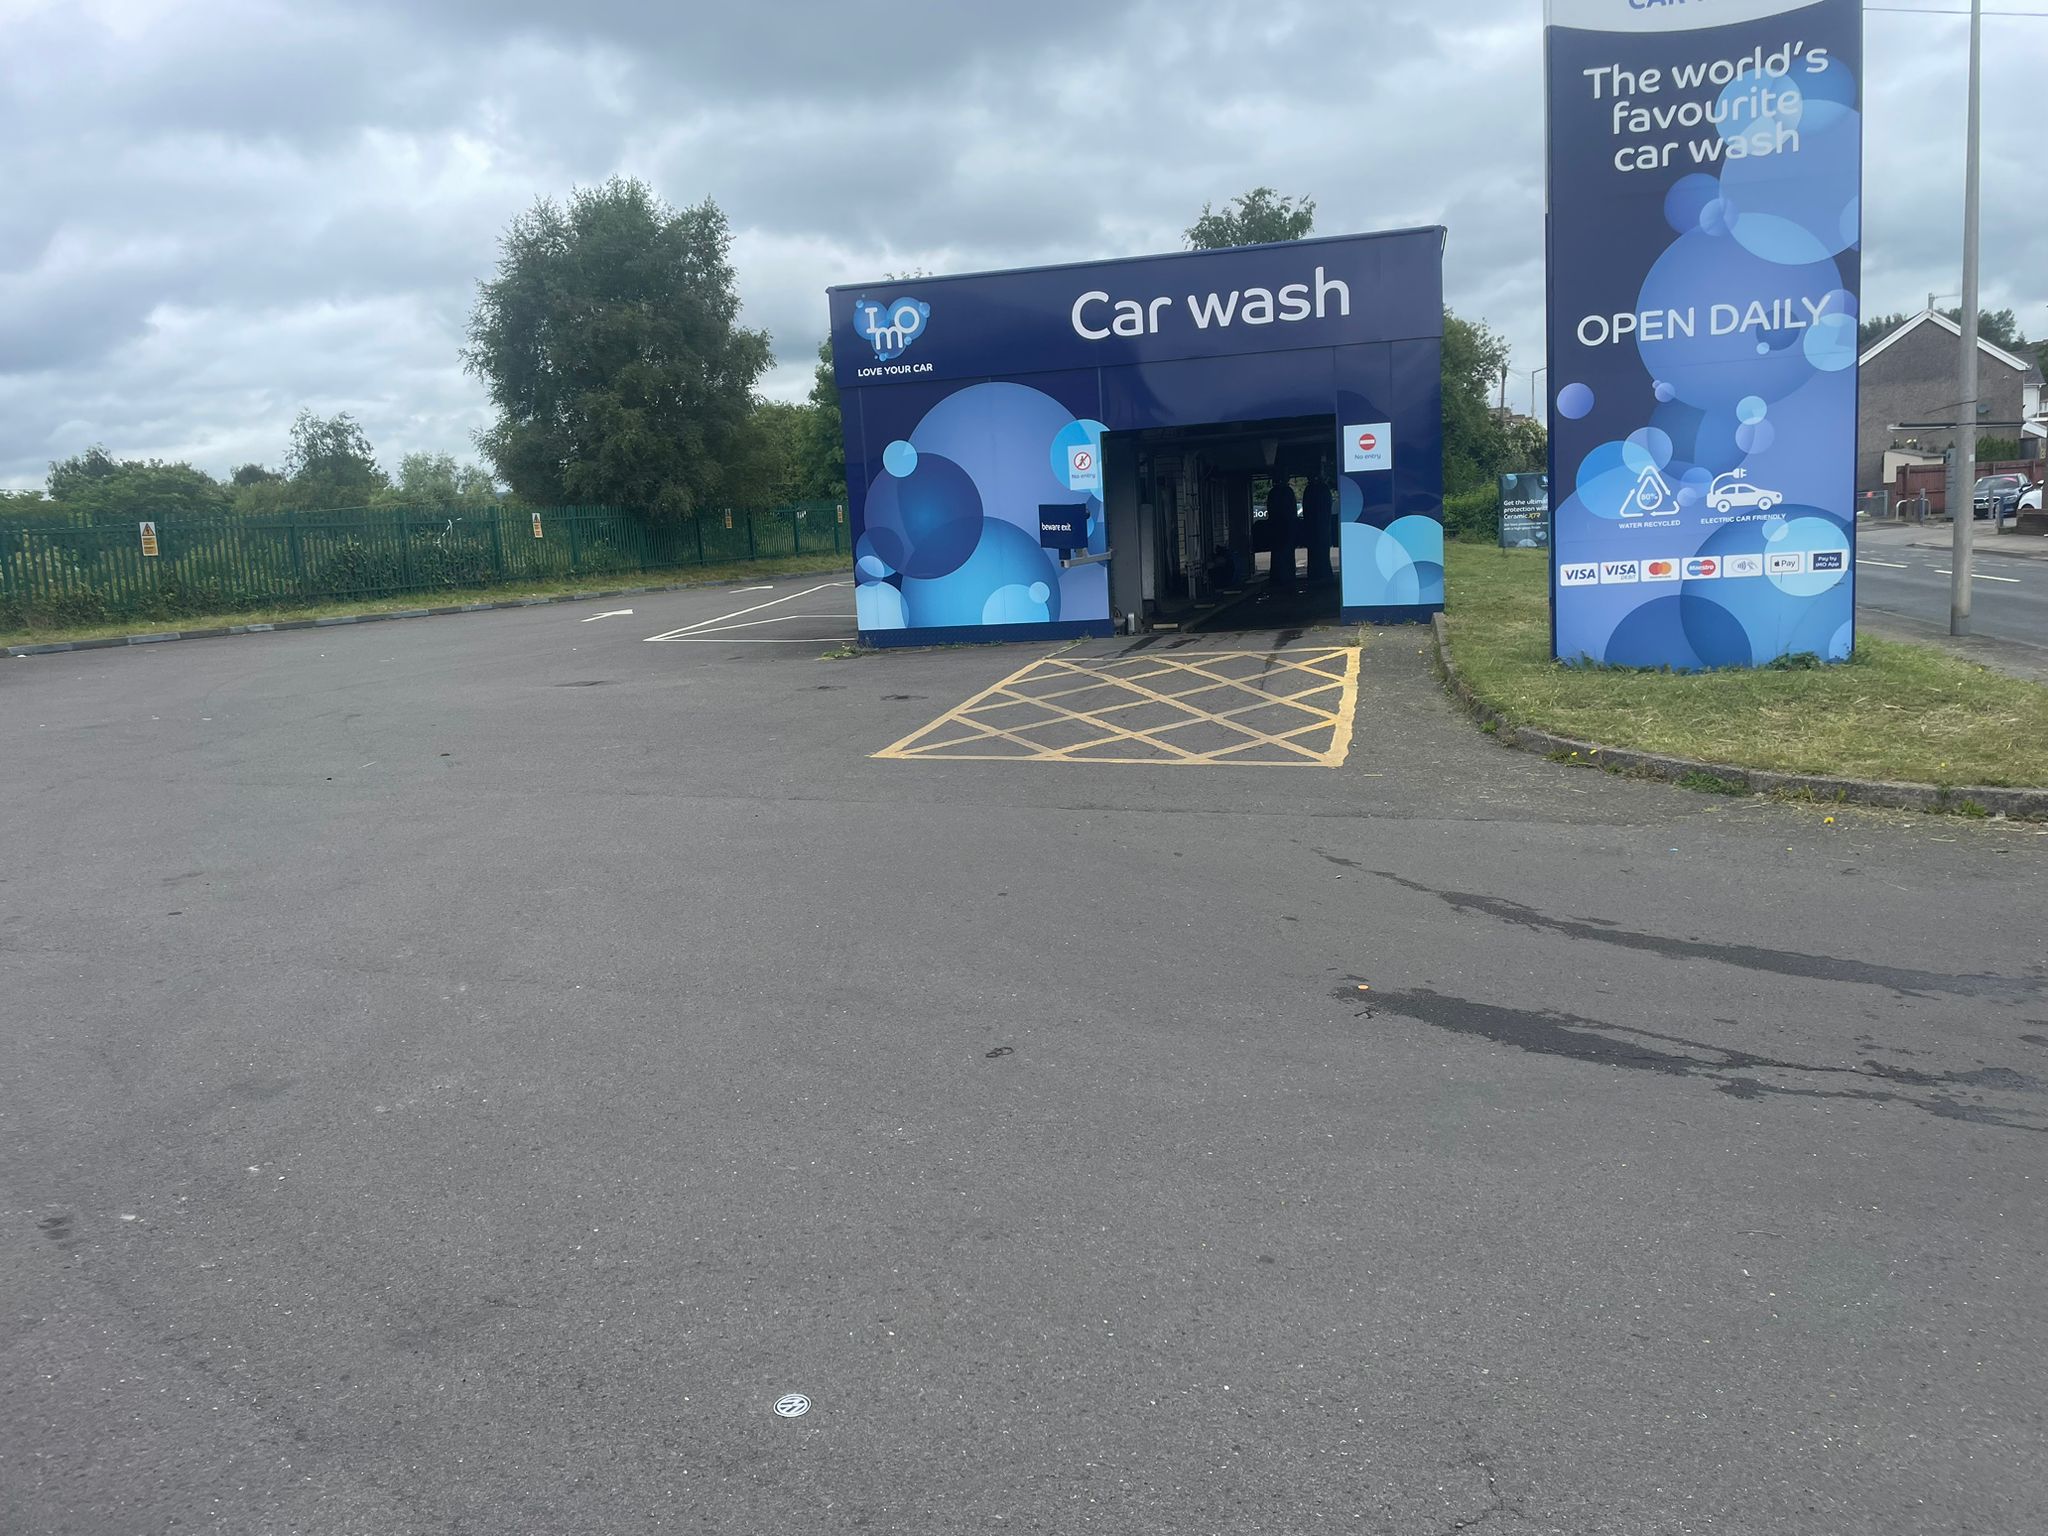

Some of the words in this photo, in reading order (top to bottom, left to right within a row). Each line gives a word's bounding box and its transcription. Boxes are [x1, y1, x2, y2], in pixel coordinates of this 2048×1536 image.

[1583, 63, 1661, 99] The
[1671, 40, 1829, 89] world's
[1613, 85, 1800, 135] favourite
[1614, 141, 1679, 172] car
[1688, 121, 1799, 164] wash
[1071, 290, 1173, 340] Car
[1187, 266, 1350, 329] wash
[1577, 307, 1695, 347] OPEN
[1710, 294, 1831, 336] DAILY
[857, 367, 883, 377] LOVE
[884, 364, 911, 375] YOUR
[913, 363, 933, 373] CAR
[1503, 506, 1535, 514] protection
[1643, 520, 1681, 528] RECYCLED
[1700, 516, 1735, 525] ELECTRIC
[1752, 513, 1787, 521] FRIENDLY
[1041, 523, 1060, 531] beware
[1061, 523, 1071, 531] exit
[1605, 564, 1636, 575] VISA
[1781, 560, 1796, 568] Pay
[1565, 568, 1596, 580] VISA
